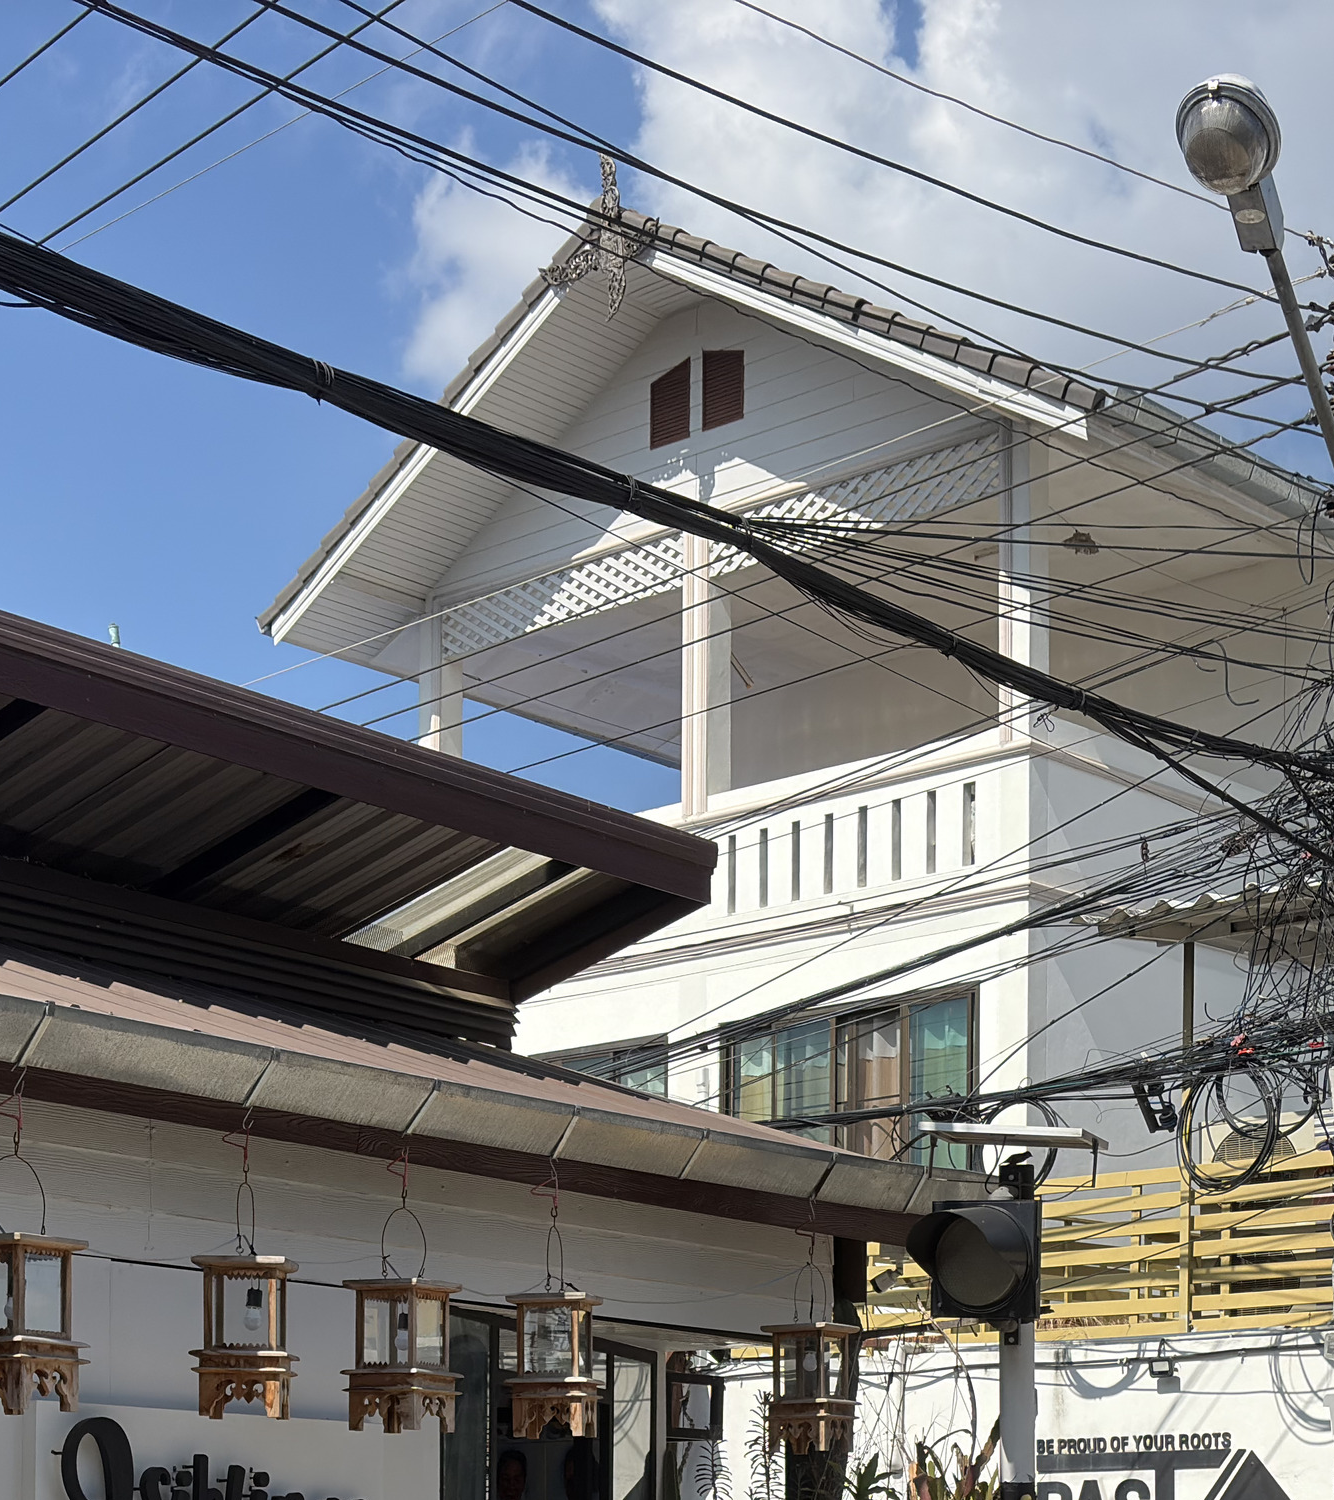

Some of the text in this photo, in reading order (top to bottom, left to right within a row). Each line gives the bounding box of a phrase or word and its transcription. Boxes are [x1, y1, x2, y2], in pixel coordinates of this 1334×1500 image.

[1036, 1432, 1232, 1455] BE PROUD OF YOUR ROOTS
